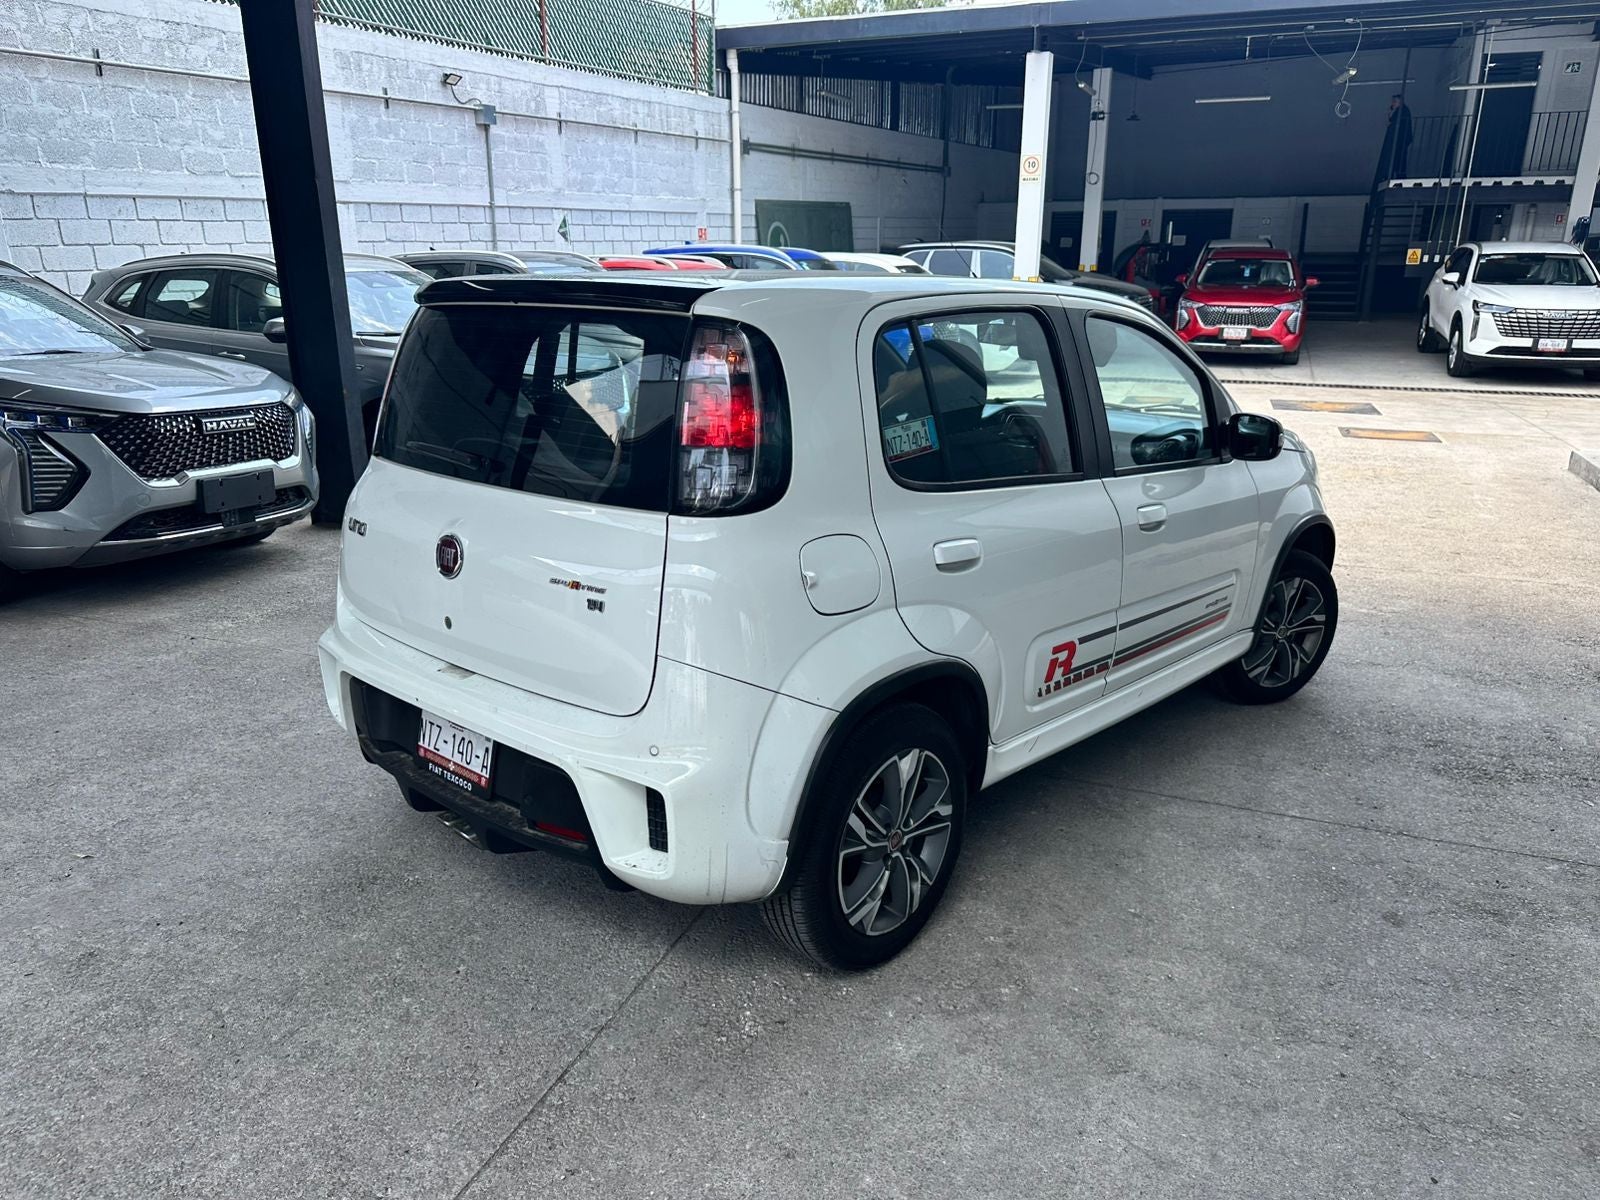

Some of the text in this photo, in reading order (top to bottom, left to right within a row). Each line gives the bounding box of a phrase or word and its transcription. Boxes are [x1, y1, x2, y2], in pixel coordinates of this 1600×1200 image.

[1027, 160, 1037, 169] 10
[1542, 310, 1572, 320] HAVAL
[205, 418, 255, 431] HAVAL
[886, 428, 931, 455] NTZ-140-A
[440, 545, 457, 568] FIAT
[419, 717, 490, 776] NTZ-140-A
[428, 762, 444, 776] FIAT
[443, 771, 472, 792] TEXCOCO
